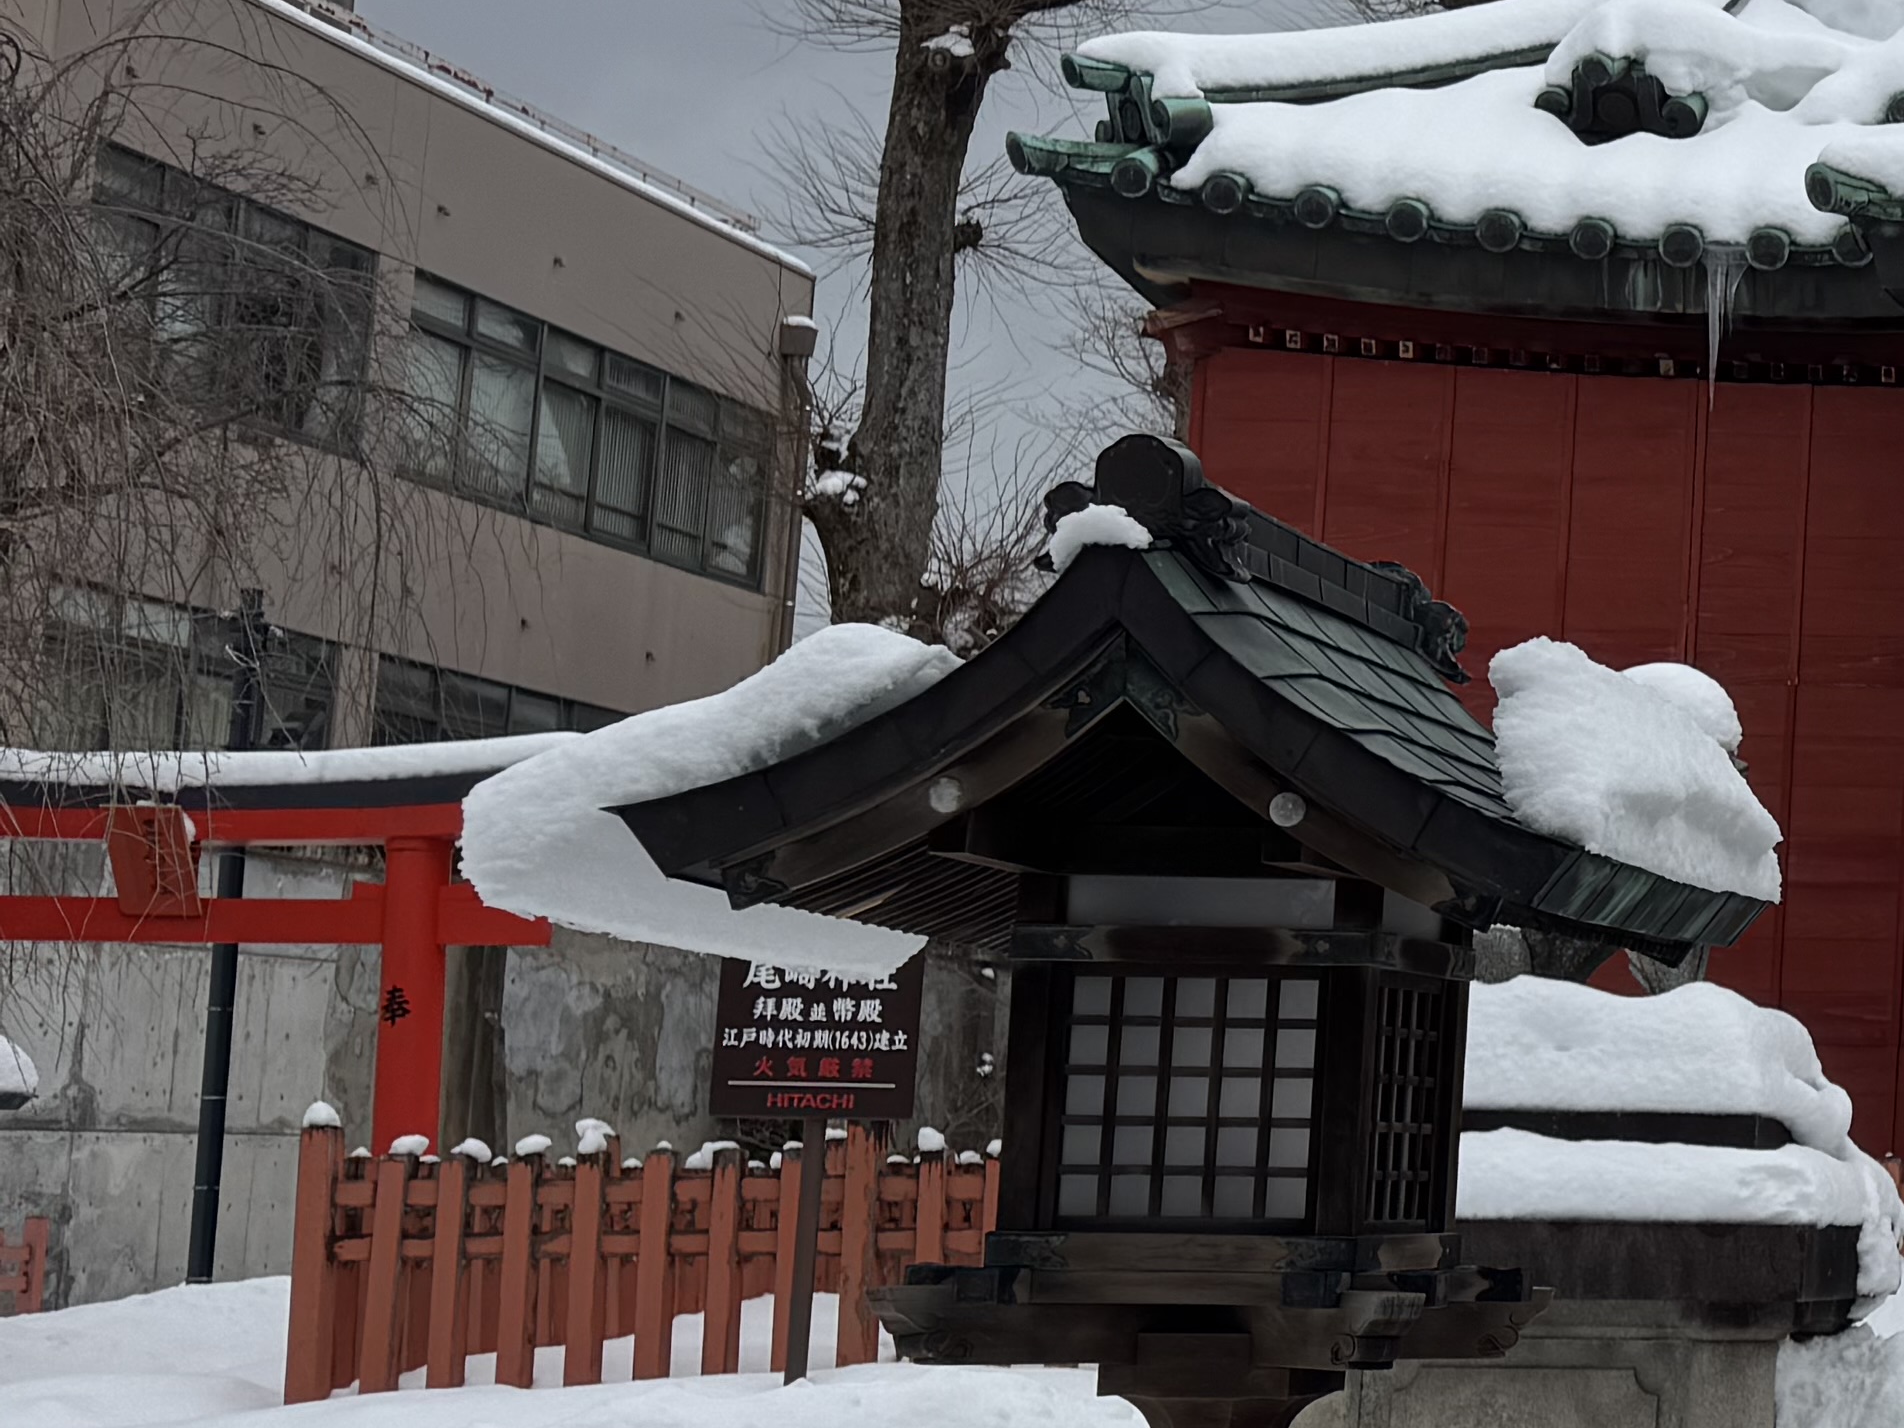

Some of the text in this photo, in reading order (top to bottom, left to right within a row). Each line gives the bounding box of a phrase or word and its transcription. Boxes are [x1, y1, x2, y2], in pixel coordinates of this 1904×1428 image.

[381, 985, 411, 1027] 奉
[752, 1055, 875, 1078] 火気厳禁
[766, 1092, 856, 1109] HITACHI
